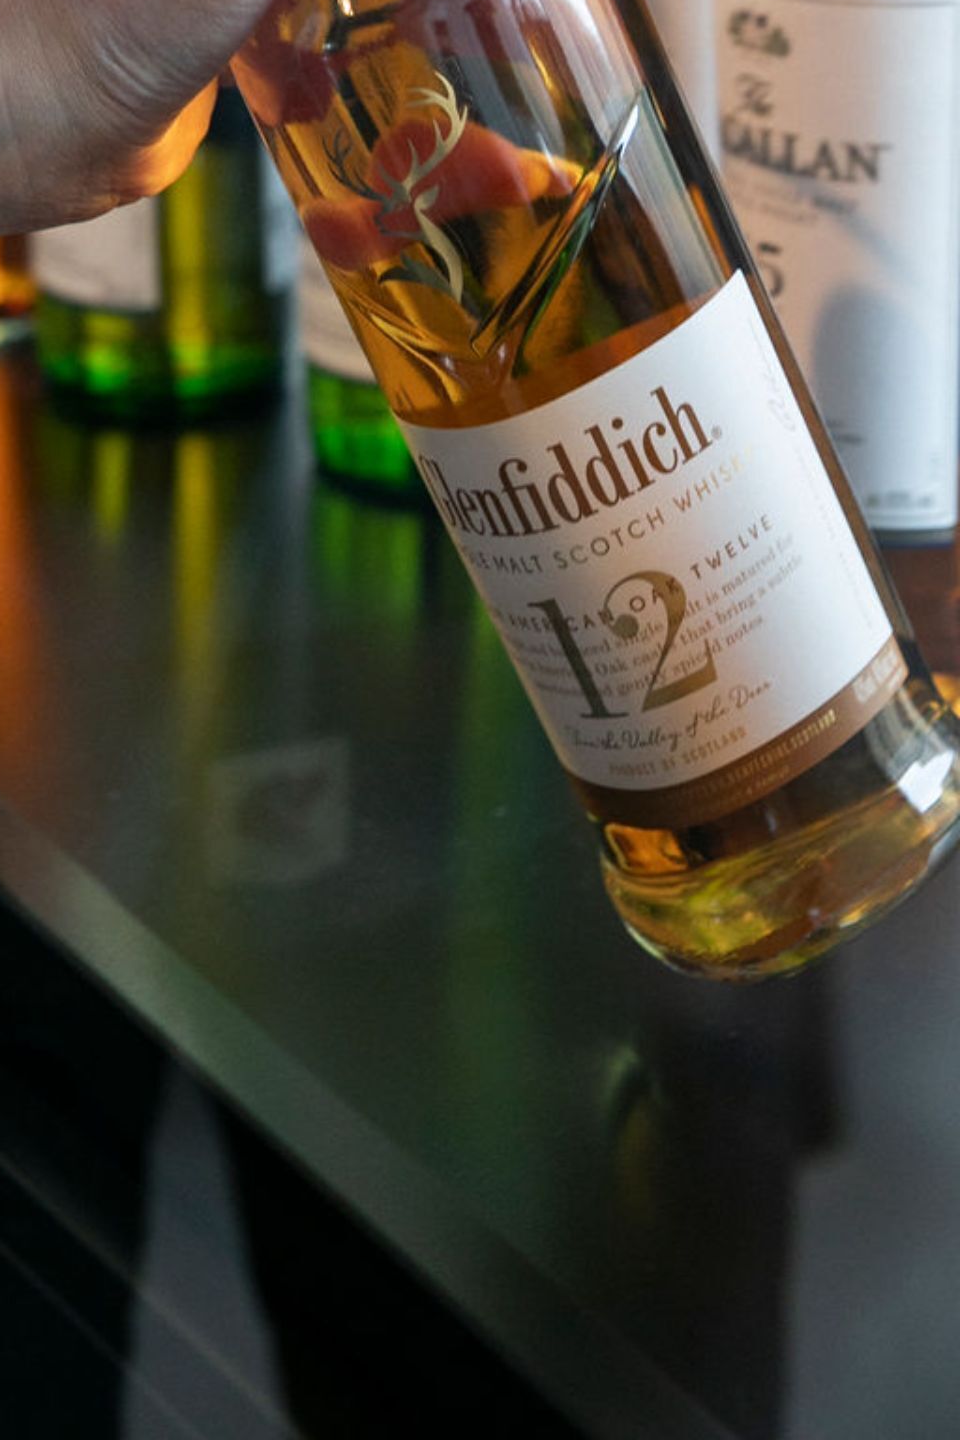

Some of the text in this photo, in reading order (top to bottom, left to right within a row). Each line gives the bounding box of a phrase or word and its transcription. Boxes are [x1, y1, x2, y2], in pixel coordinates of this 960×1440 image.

[420, 386, 712, 537] Glenfiddich
[492, 555, 543, 575] MALT
[553, 508, 665, 569] SCOTCH
[509, 609, 615, 634] AMERCAN
[629, 577, 681, 612] OAK
[690, 514, 773, 580] TWELVE
[527, 570, 721, 719] 12
